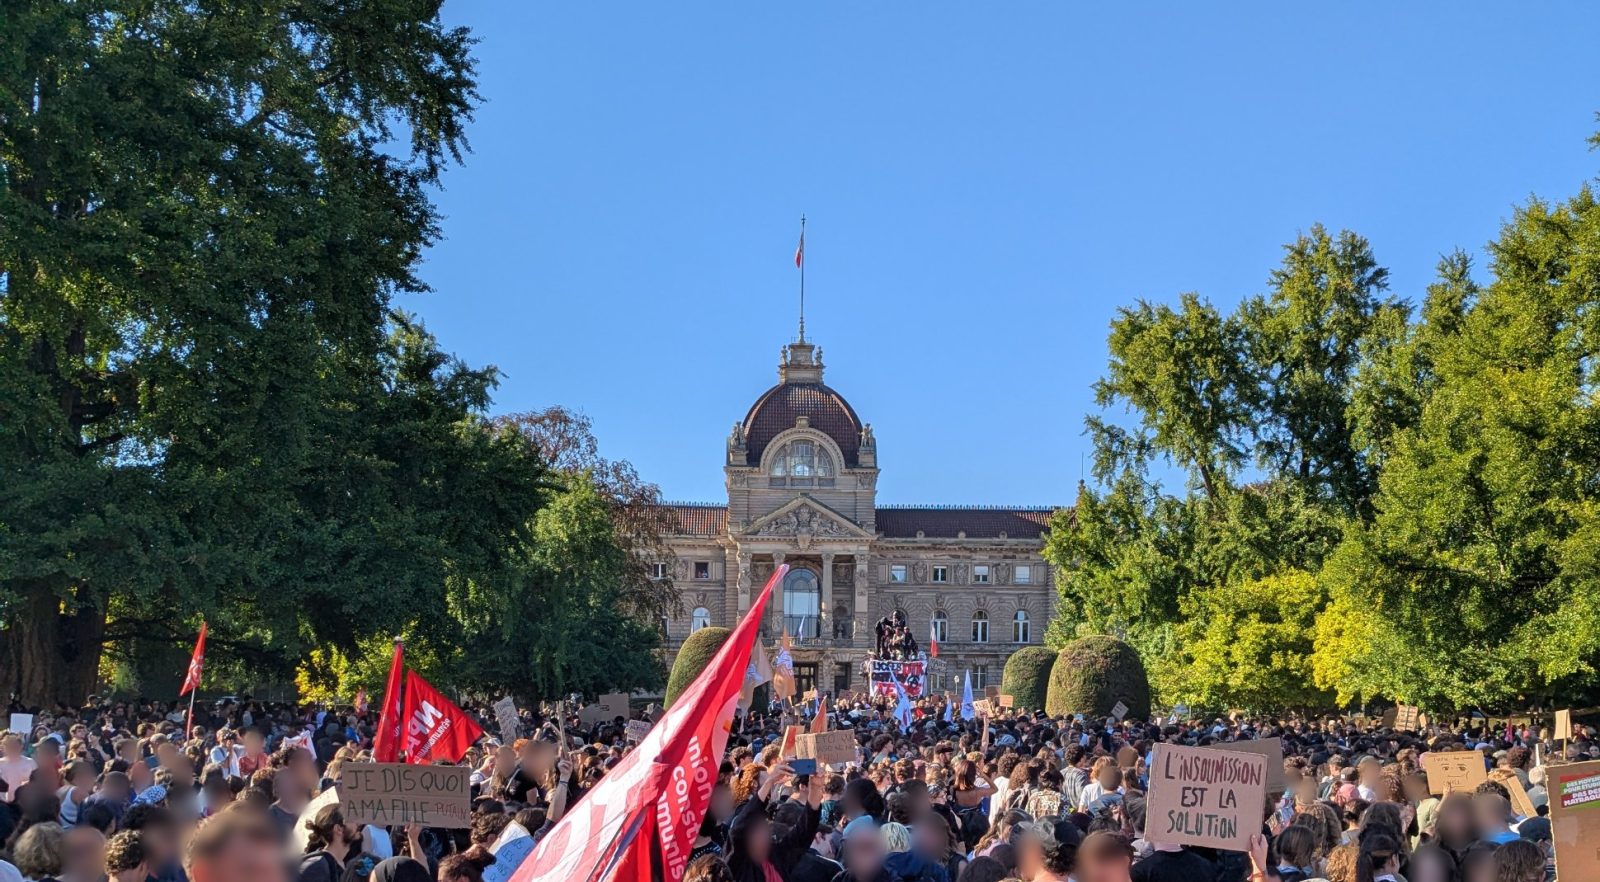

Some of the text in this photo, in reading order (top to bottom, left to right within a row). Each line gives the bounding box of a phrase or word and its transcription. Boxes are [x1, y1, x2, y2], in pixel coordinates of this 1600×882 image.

[347, 770, 376, 792] JE
[1181, 786, 1236, 808] EST LA
[1572, 790, 1587, 798] PAS
[361, 798, 388, 821] MA
